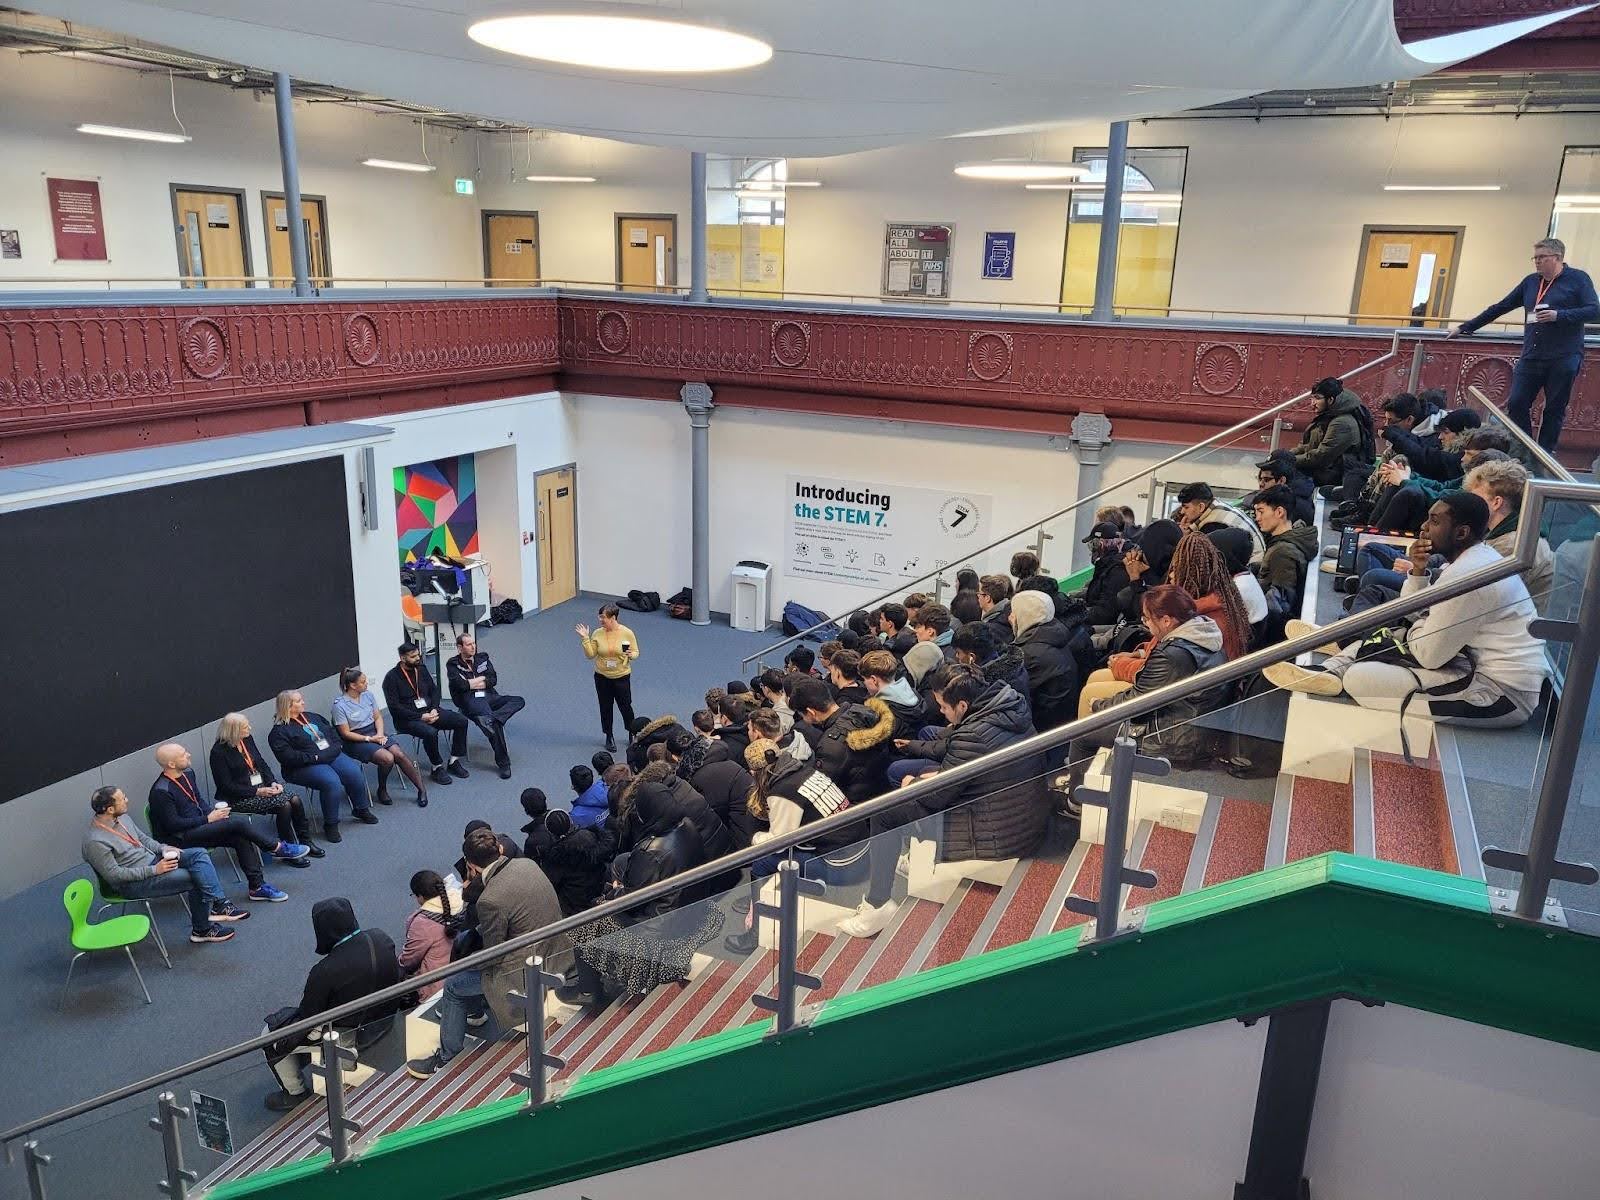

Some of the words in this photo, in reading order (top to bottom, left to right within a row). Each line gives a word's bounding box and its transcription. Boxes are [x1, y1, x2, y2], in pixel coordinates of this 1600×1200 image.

[924, 261, 942, 271] NHS
[795, 481, 891, 511] Introducing
[794, 502, 821, 520] the
[824, 505, 871, 526] STEM
[874, 511, 888, 528] 7.
